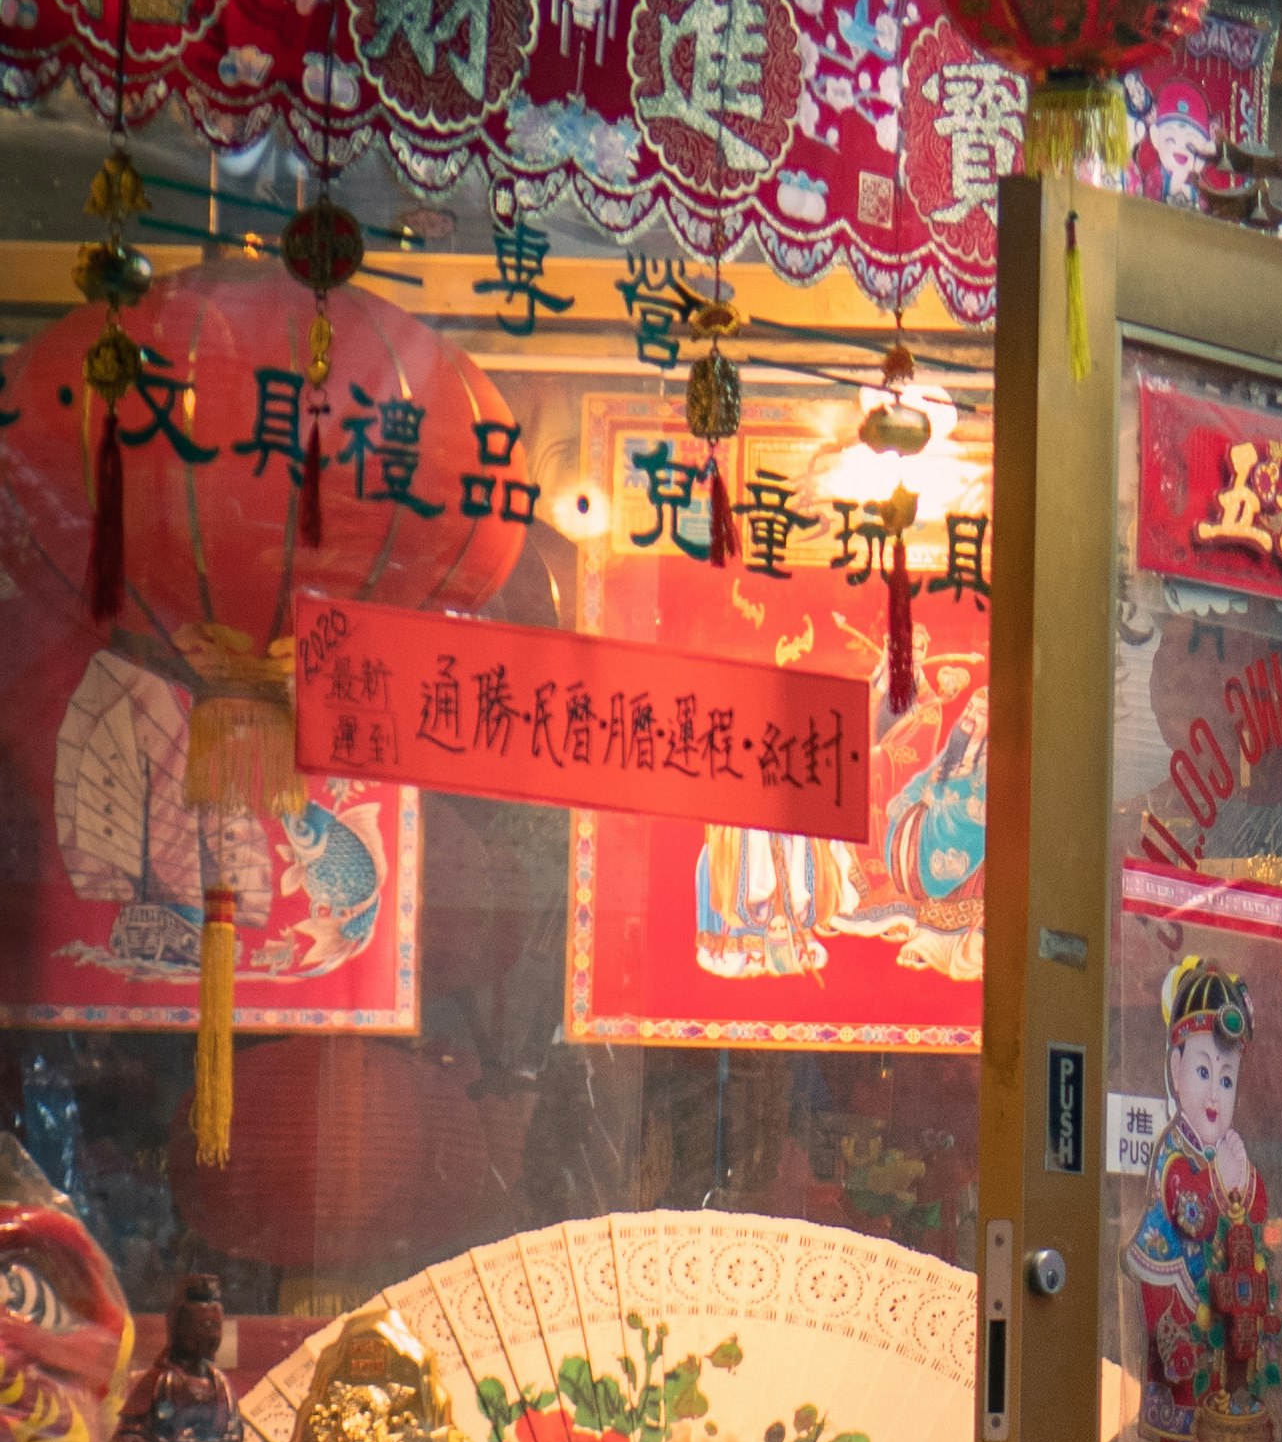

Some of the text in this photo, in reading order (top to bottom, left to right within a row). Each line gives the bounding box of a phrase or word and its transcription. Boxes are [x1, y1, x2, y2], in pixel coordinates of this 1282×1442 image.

[298, 607, 348, 686] 2020
[1058, 1056, 1076, 1166] PUSH
[1126, 1104, 1154, 1136] 推
[1119, 1138, 1154, 1166] PUS
